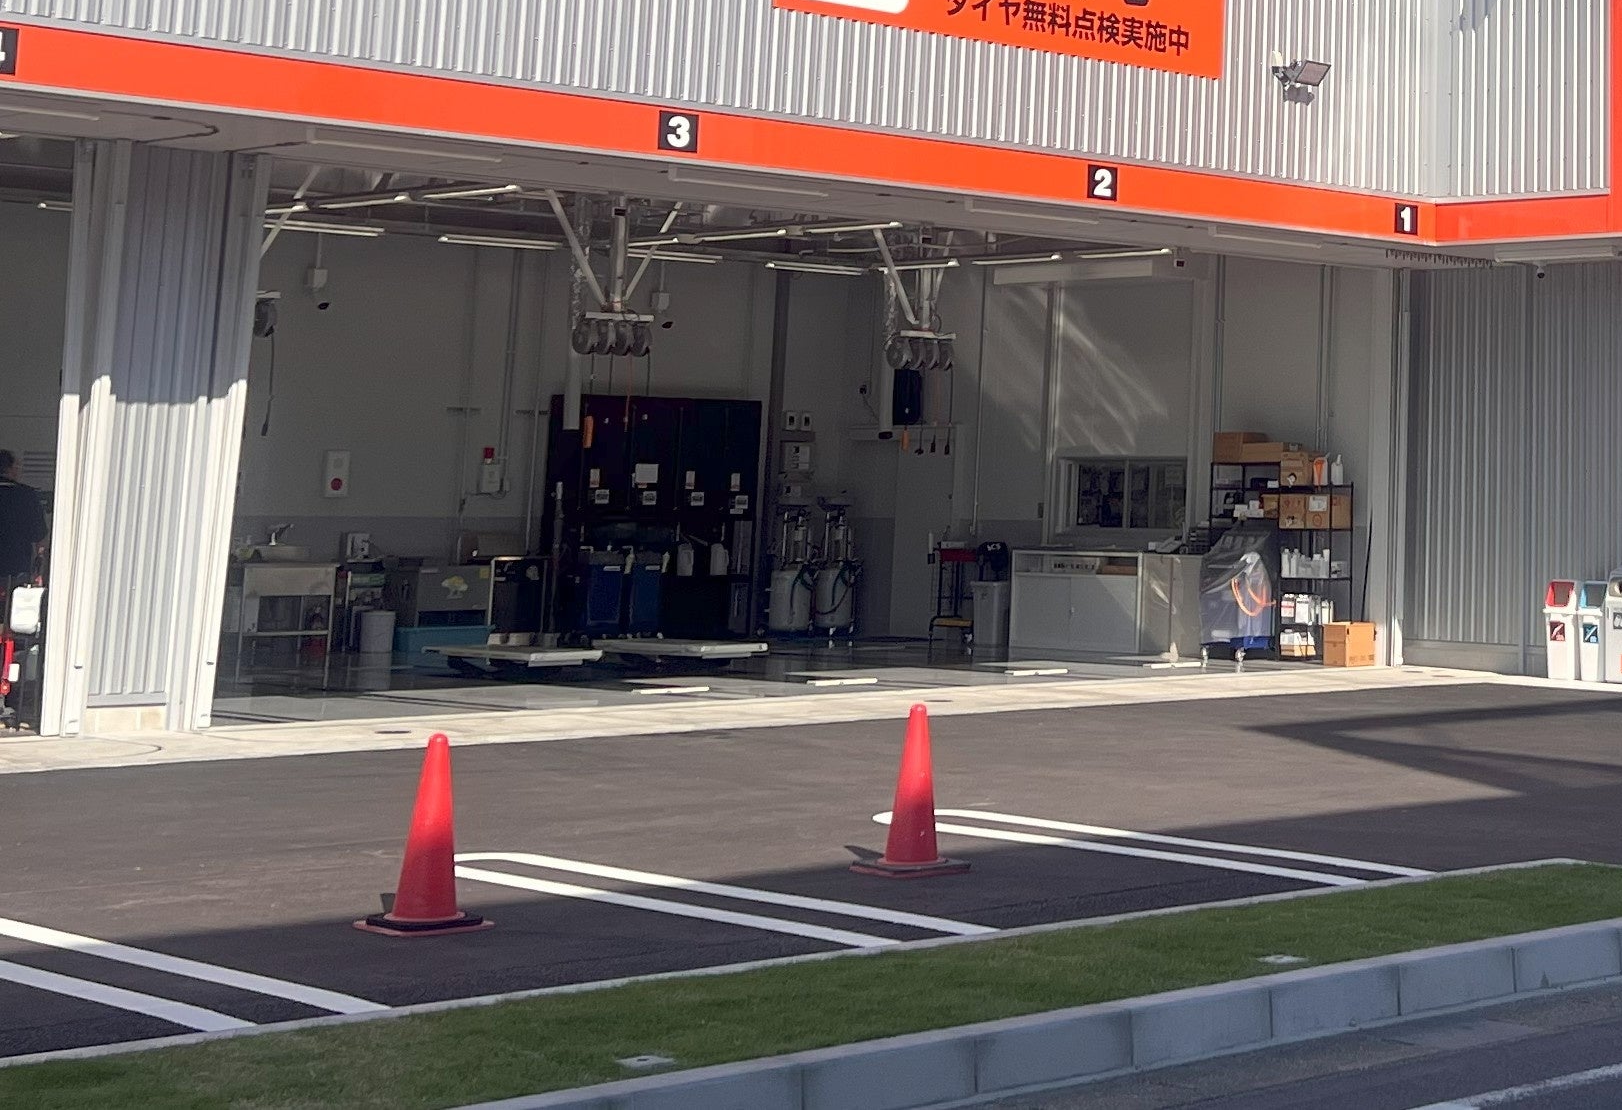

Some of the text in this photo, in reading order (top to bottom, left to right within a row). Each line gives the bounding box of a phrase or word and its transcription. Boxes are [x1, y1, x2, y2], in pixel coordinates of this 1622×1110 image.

[667, 116, 690, 149] 3
[1093, 169, 1112, 197] 2
[1400, 206, 1411, 232] 1
